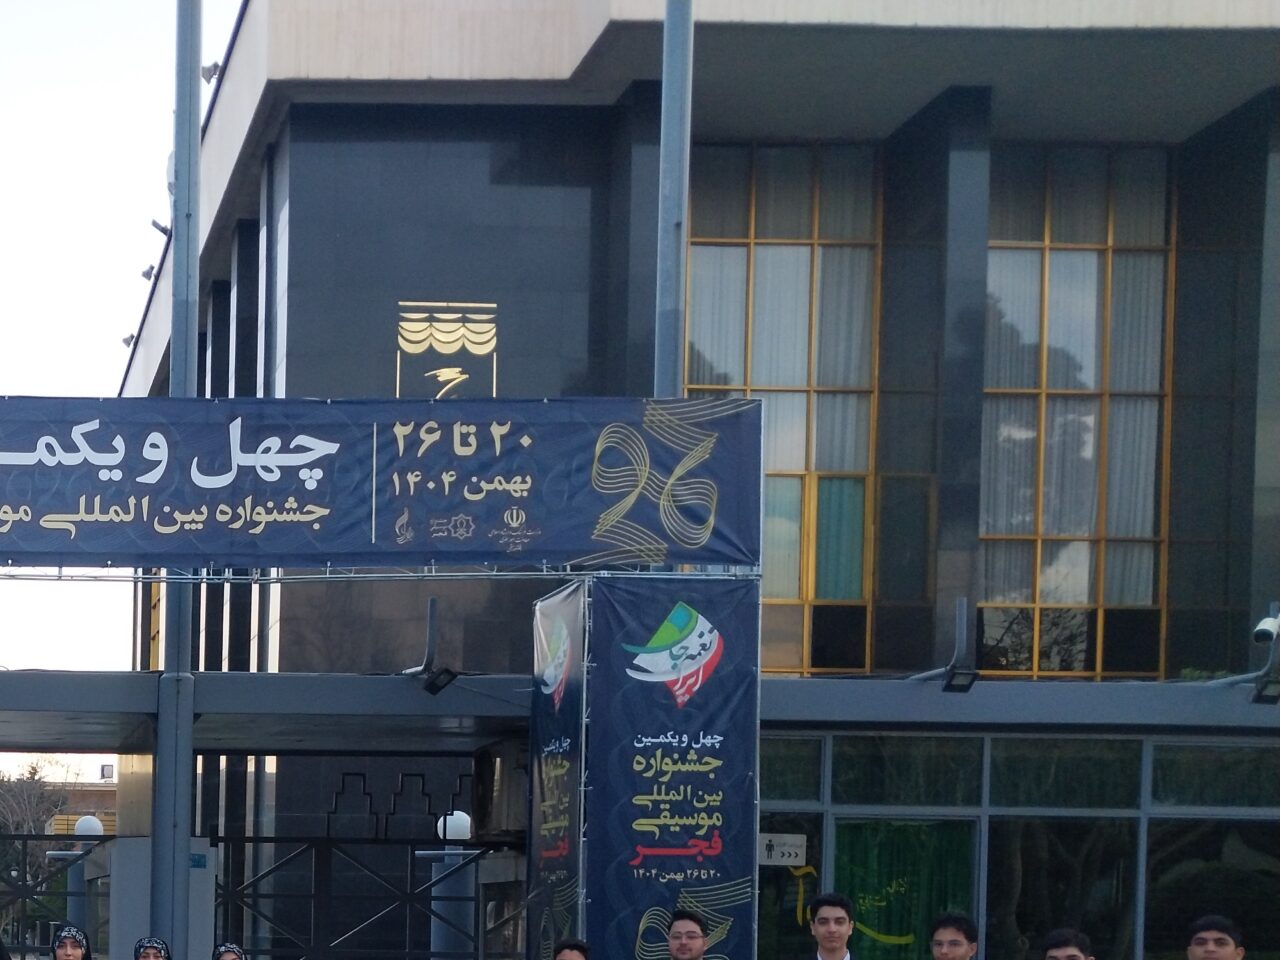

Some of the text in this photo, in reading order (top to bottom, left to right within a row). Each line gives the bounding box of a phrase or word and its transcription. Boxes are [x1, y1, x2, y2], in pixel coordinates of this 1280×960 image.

[190, 416, 340, 490] چهل
[393, 420, 532, 457] ۲۰ تا ۲۶
[135, 432, 169, 484] و
[392, 471, 532, 500] بهمن ۱۴۰۴
[39, 494, 150, 540] المللی
[153, 505, 208, 534] بین
[215, 495, 331, 534] جشنواره
[633, 731, 724, 750] چهل و یکمین
[632, 748, 724, 782] جشنواره
[632, 785, 723, 811] بین المللی
[632, 808, 723, 840] موسیقی
[629, 830, 724, 866] فجر
[659, 871, 685, 882] بهمن
[687, 869, 699, 879] ۲۶
[700, 869, 708, 879] تا
